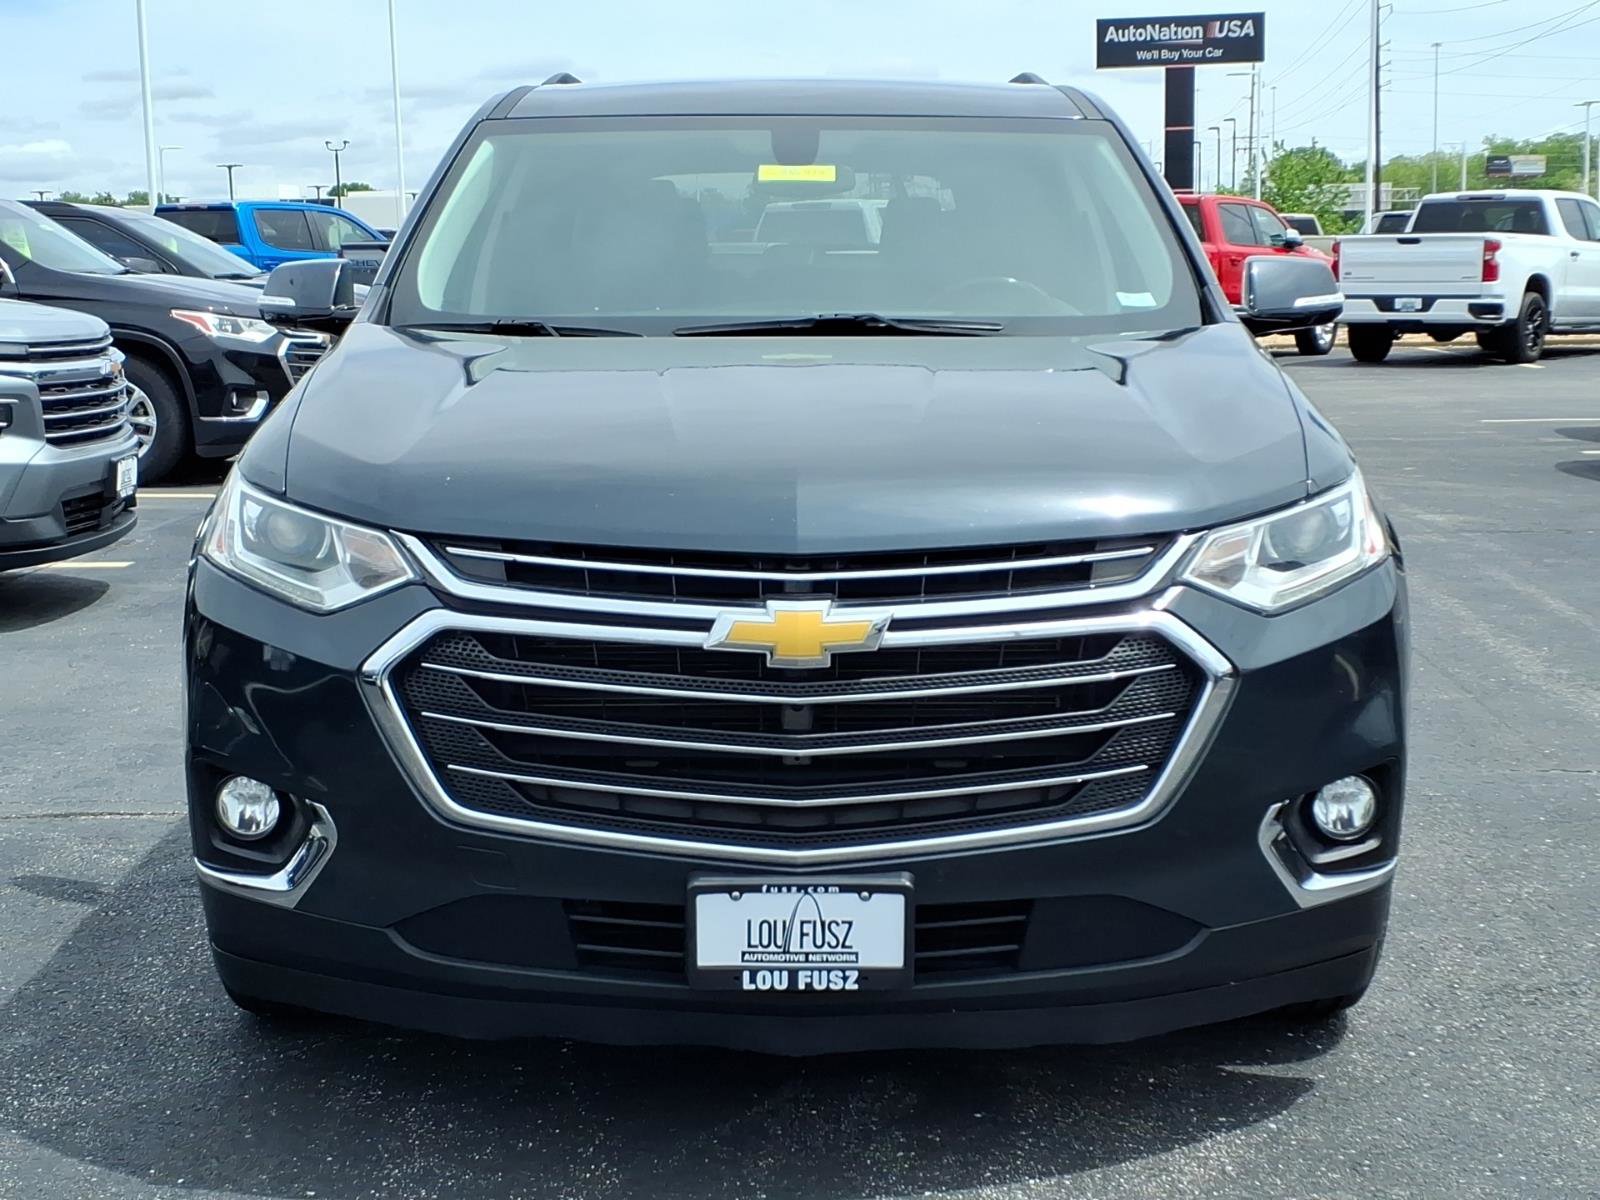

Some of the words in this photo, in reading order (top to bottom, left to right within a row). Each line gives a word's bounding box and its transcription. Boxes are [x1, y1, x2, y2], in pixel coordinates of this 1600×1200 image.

[1104, 23, 1203, 42] AutoNation
[1214, 19, 1255, 38] USA
[1136, 49, 1159, 60] We'll
[1161, 49, 1180, 60] Buy
[1181, 48, 1204, 58] Your
[1205, 47, 1224, 57] Car
[762, 884, 840, 894] fusz.com
[747, 919, 787, 950] LOU
[799, 919, 854, 950] FUSZ
[743, 953, 806, 962] AUTOMOTIVE
[808, 953, 857, 962] NETWORK
[742, 970, 789, 991] LOU
[798, 970, 860, 991] FUSZ
